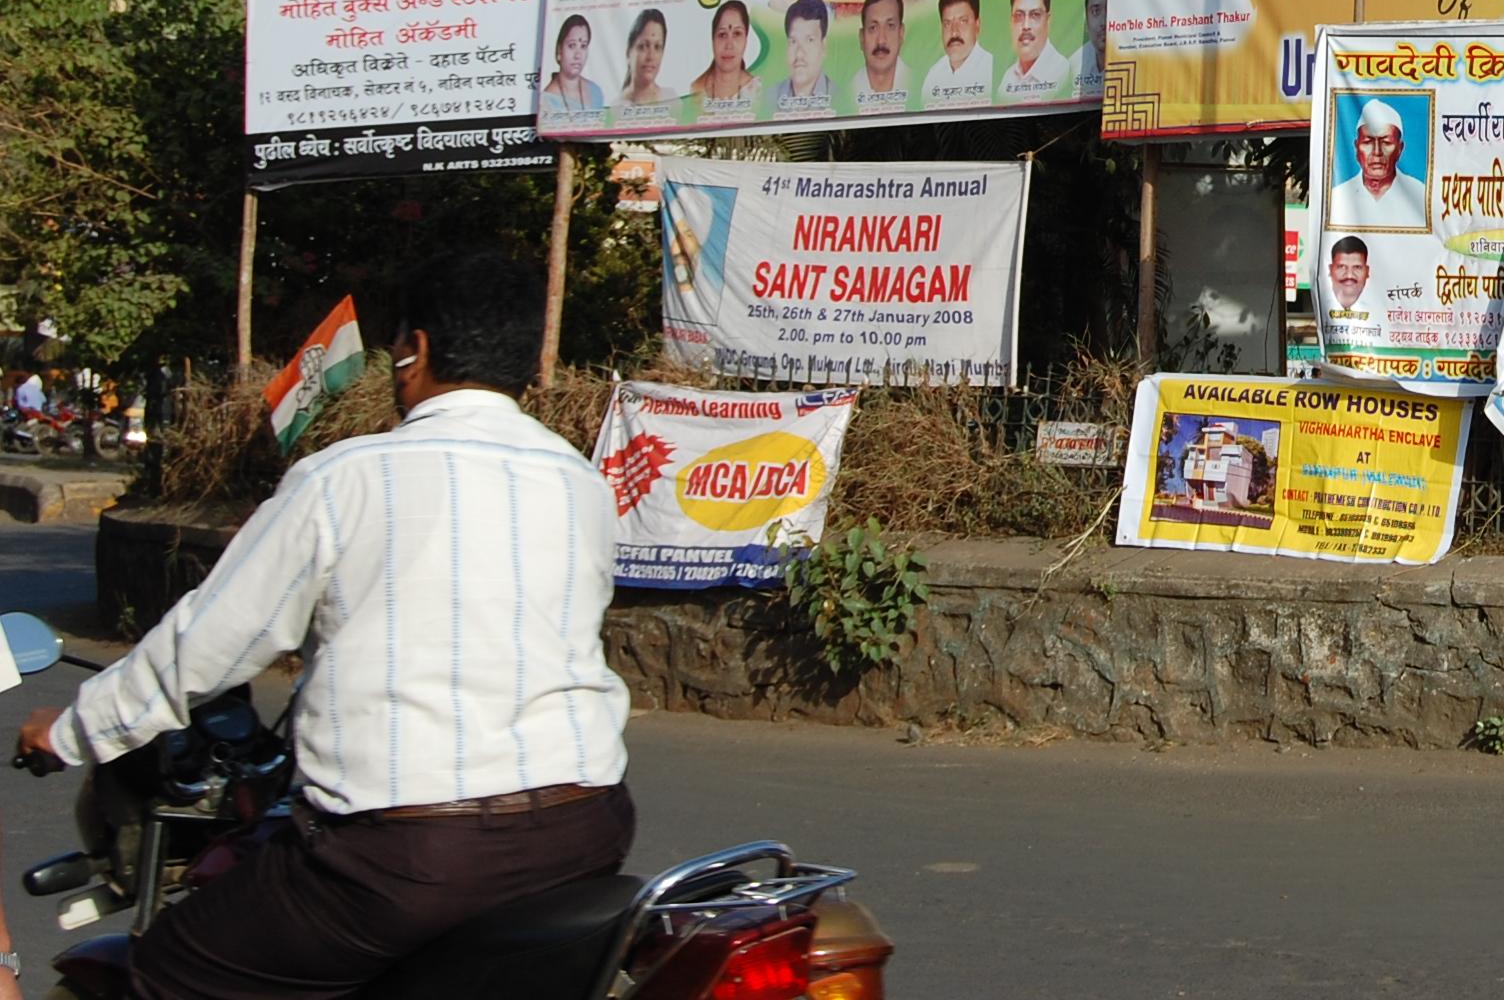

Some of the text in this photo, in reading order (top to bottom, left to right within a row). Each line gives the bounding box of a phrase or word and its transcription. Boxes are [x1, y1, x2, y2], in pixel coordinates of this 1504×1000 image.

[1170, 14, 1213, 27] Prashant
[1217, 11, 1251, 22] Thakur
[1334, 42, 1456, 81] गावदेवी
[762, 175, 987, 199] 41st Maharashtra Annual
[793, 214, 942, 252] NIRANKARI
[753, 261, 972, 303] SANT SAMAGAM
[747, 304, 974, 328] 25th, 26th & 27th January 2008
[813, 332, 835, 346] pm
[840, 332, 854, 344] to
[860, 331, 901, 345] 10.00
[905, 334, 927, 349] pm
[701, 400, 782, 419] Learning
[1183, 383, 1439, 422] AVAILABLE ROW HOUSES
[1299, 421, 1441, 448] VIGHNAHARTHA ENCLAVE
[1356, 452, 1371, 464] AT
